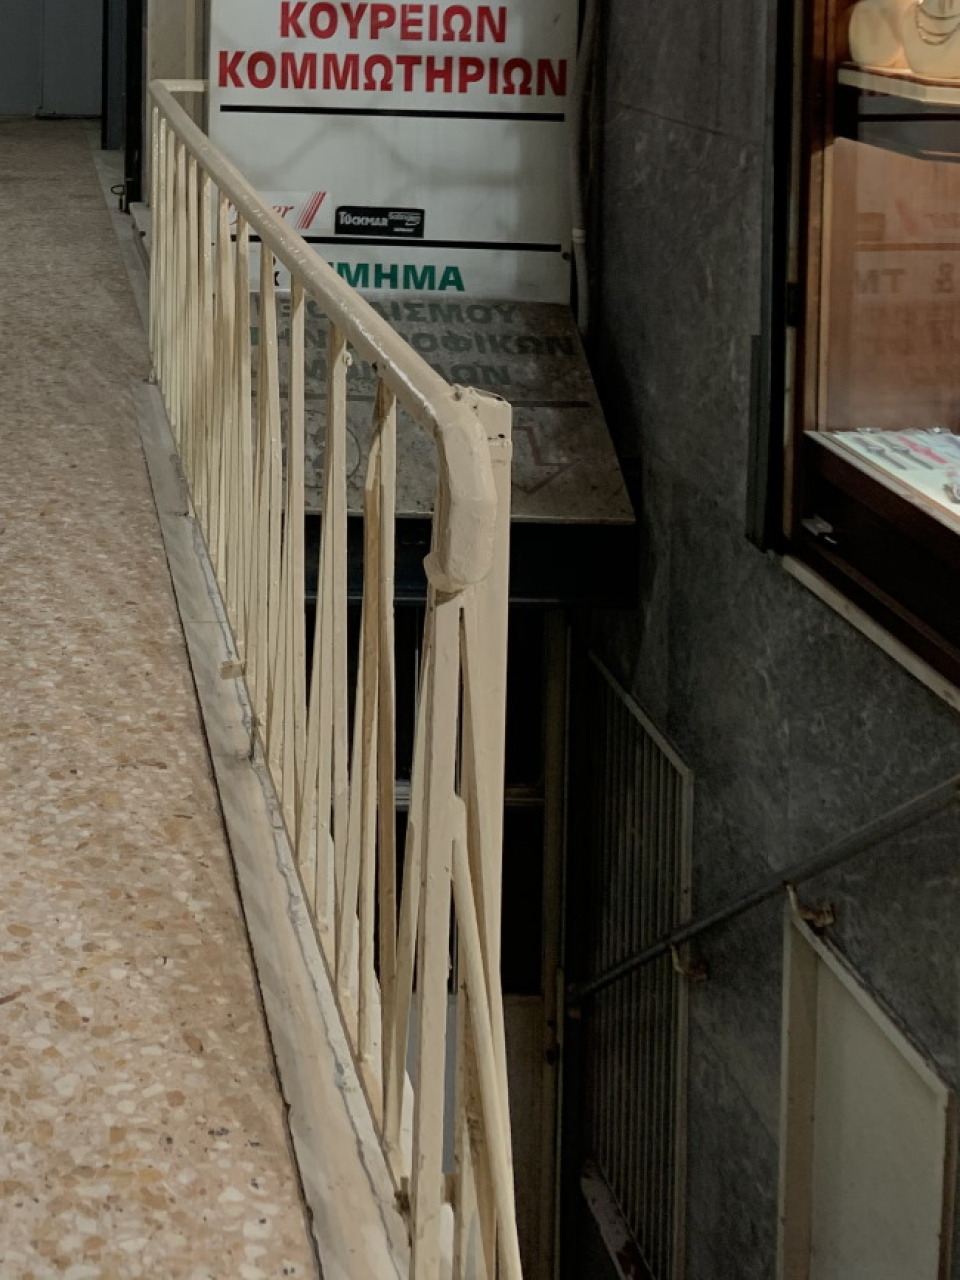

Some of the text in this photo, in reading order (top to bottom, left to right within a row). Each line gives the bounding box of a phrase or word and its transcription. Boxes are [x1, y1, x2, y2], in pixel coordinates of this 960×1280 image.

[279, 1, 508, 43] ΚΟΥΡΕΙΩΝ
[218, 50, 568, 96] ΚΟΜΜΩΤΗΡΙΩΝ
[328, 261, 465, 292] ΜΗΜΑ
